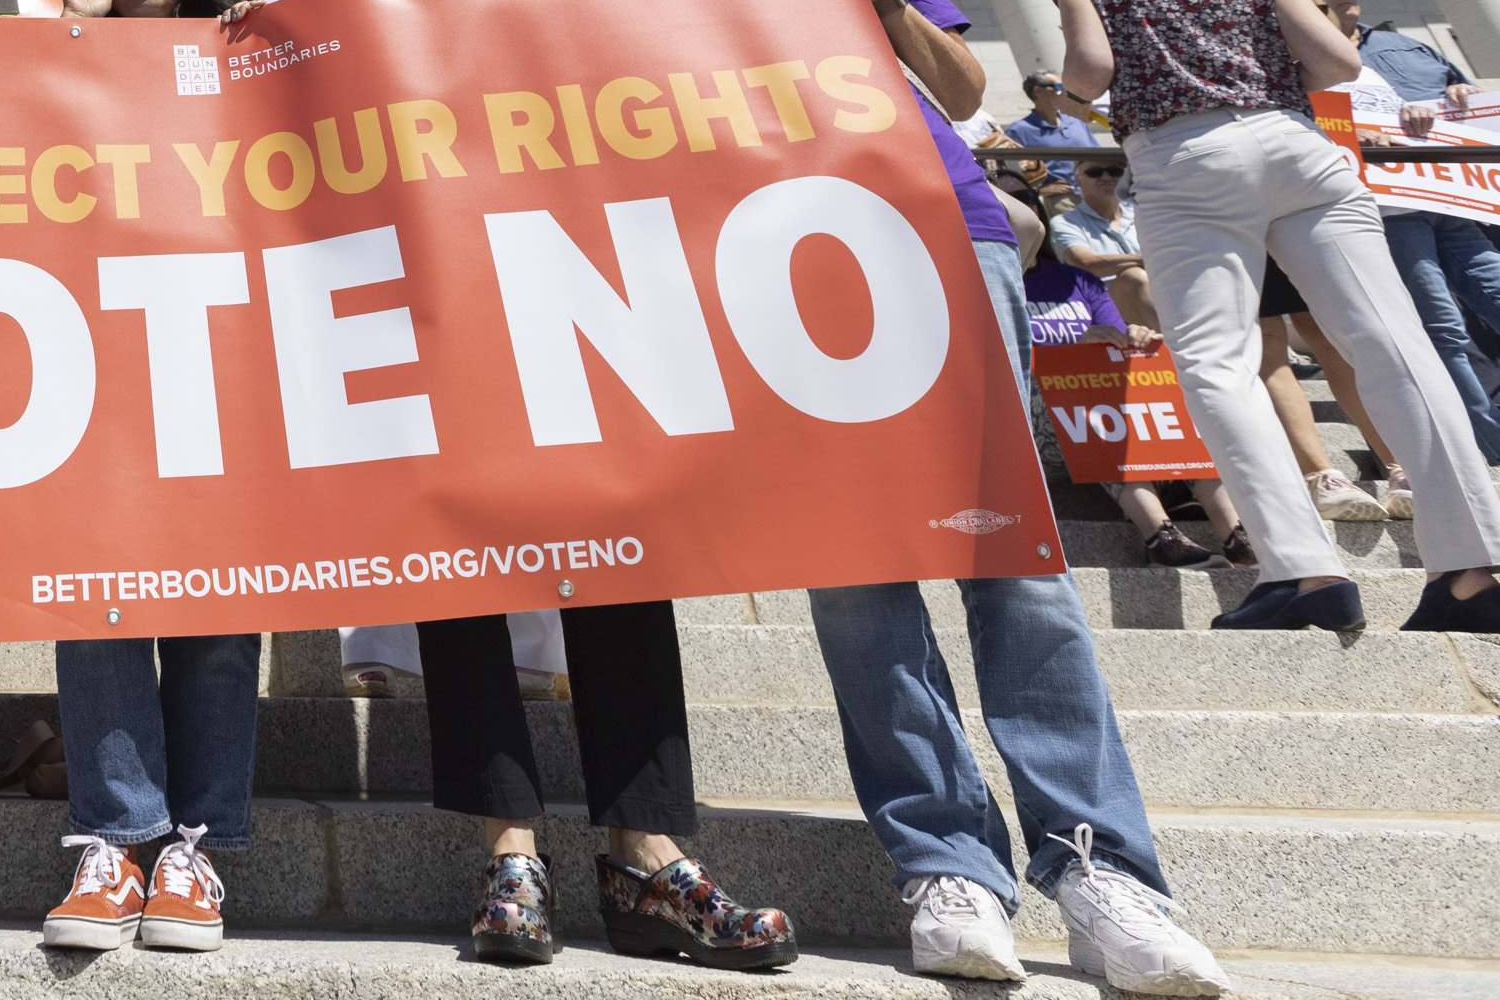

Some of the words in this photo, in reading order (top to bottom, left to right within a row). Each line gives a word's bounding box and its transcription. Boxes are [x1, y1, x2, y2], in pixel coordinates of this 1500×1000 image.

[228, 40, 295, 68] BETTER
[230, 39, 342, 81] BOUNDARIES
[171, 99, 468, 217] YOUR
[483, 54, 897, 174] RIGHTS
[483, 174, 950, 447] NO
[1026, 301, 1092, 320] RMON
[1040, 372, 1122, 391] PROTECT
[1127, 370, 1178, 387] YOUR
[1051, 402, 1185, 444] VOTE
[31, 536, 644, 604] BETTERBOUNDARIES.ORG/VOTENO
